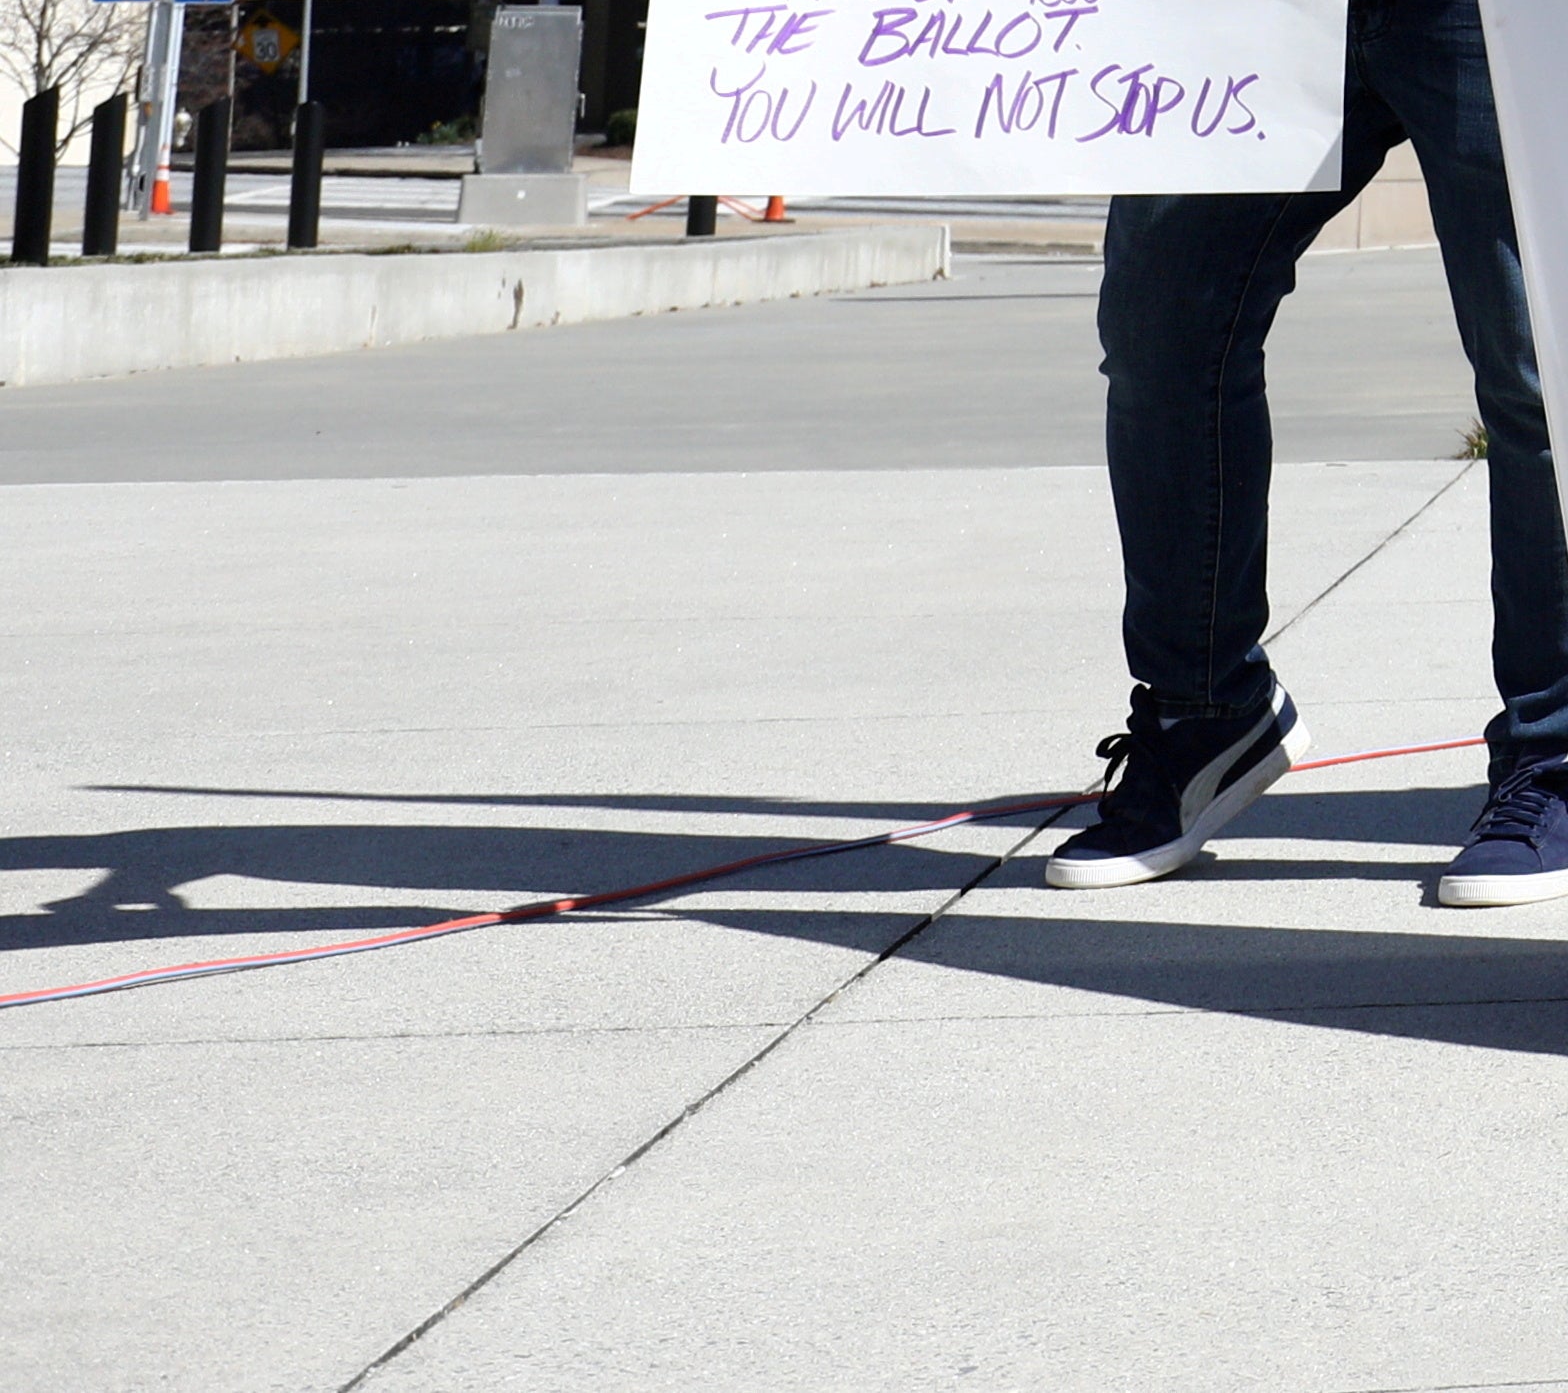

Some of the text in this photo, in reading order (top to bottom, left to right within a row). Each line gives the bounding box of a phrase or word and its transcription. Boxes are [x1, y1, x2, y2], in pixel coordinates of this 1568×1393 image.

[705, 4, 1099, 66] THE BALLOT.
[710, 62, 1267, 144] YOU WILL NOT STOP US.
